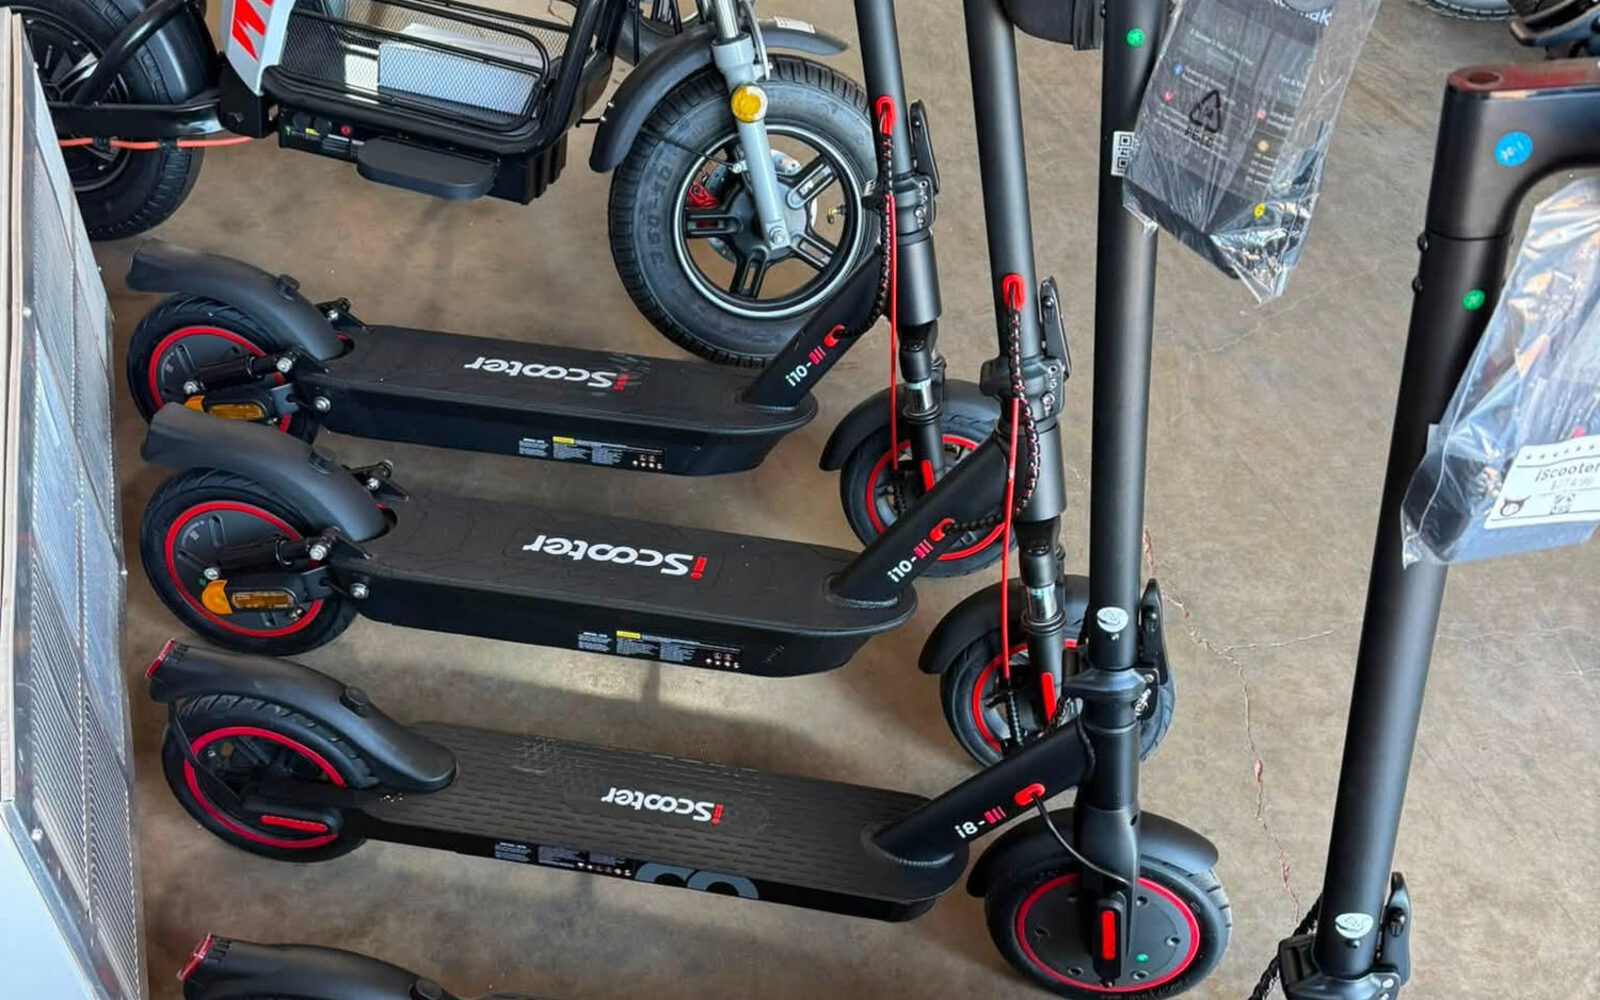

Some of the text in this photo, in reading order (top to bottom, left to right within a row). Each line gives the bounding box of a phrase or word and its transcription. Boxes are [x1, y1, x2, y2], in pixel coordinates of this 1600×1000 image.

[463, 356, 629, 392] iScooter
[522, 535, 708, 580] iScooter
[601, 787, 723, 825] iScooter
